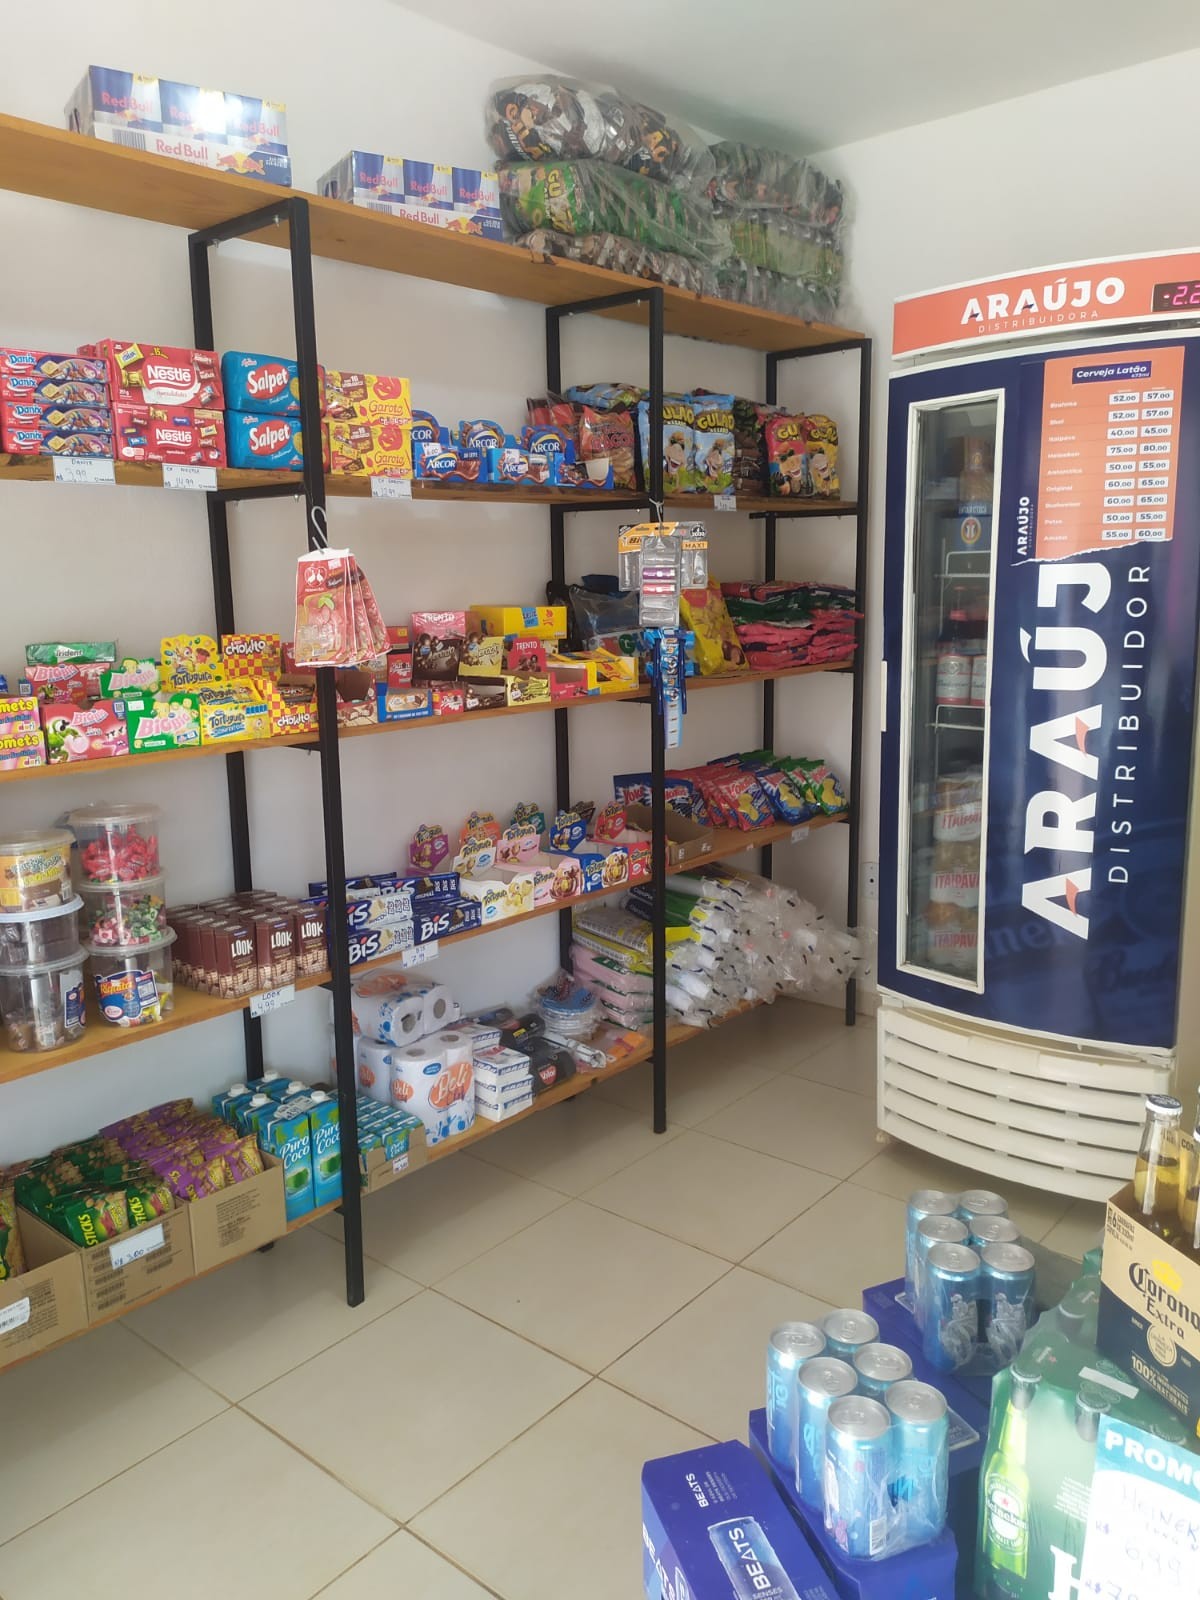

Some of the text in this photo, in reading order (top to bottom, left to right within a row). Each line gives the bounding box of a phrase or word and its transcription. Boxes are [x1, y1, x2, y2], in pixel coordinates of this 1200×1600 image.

[102, 92, 153, 111] Red Bull
[259, 125, 280, 137] Bull
[155, 138, 209, 161] Red Bull
[359, 172, 399, 188] Red Bull
[410, 180, 448, 195] Red Bull
[459, 188, 495, 202] Red Bull
[399, 208, 440, 225] Red Bull
[960, 276, 1125, 325] ARAÚJO
[978, 309, 1100, 334] DISTRIBUIDORA
[9, 354, 36, 365] Danix
[1076, 365, 1147, 378] Cerveja Latão
[10, 377, 37, 388] Danix
[247, 368, 289, 394] Salpet
[15, 404, 43, 415] Danix
[369, 400, 403, 413] Garoto
[17, 430, 43, 441] Danix
[249, 425, 291, 451] Salpet
[469, 437, 498, 449] ARCOR
[530, 442, 560, 453] ARCOR
[374, 451, 404, 465] Garoto
[426, 457, 457, 469] ARCOR
[1017, 496, 1030, 556] ARAÚJO
[516, 642, 538, 650] TRENTO
[170, 669, 213, 687] Tortuguita
[209, 711, 246, 727] Tortuguita
[301, 922, 323, 938] LOOK
[421, 913, 450, 942] BiS
[231, 939, 253, 957] LOOK
[271, 931, 292, 949] LOOK
[349, 934, 379, 965] BiS
[280, 1135, 310, 1159] Puro
[284, 1146, 310, 1169] Coco
[78, 1213, 99, 1246] STICKS
[1128, 1262, 1200, 1333] Corona
[1144, 1298, 1185, 1340] Extra
[1132, 1355, 1158, 1386] 100%
[685, 1472, 709, 1508] BEATS
[729, 1527, 772, 1590] BEATS
